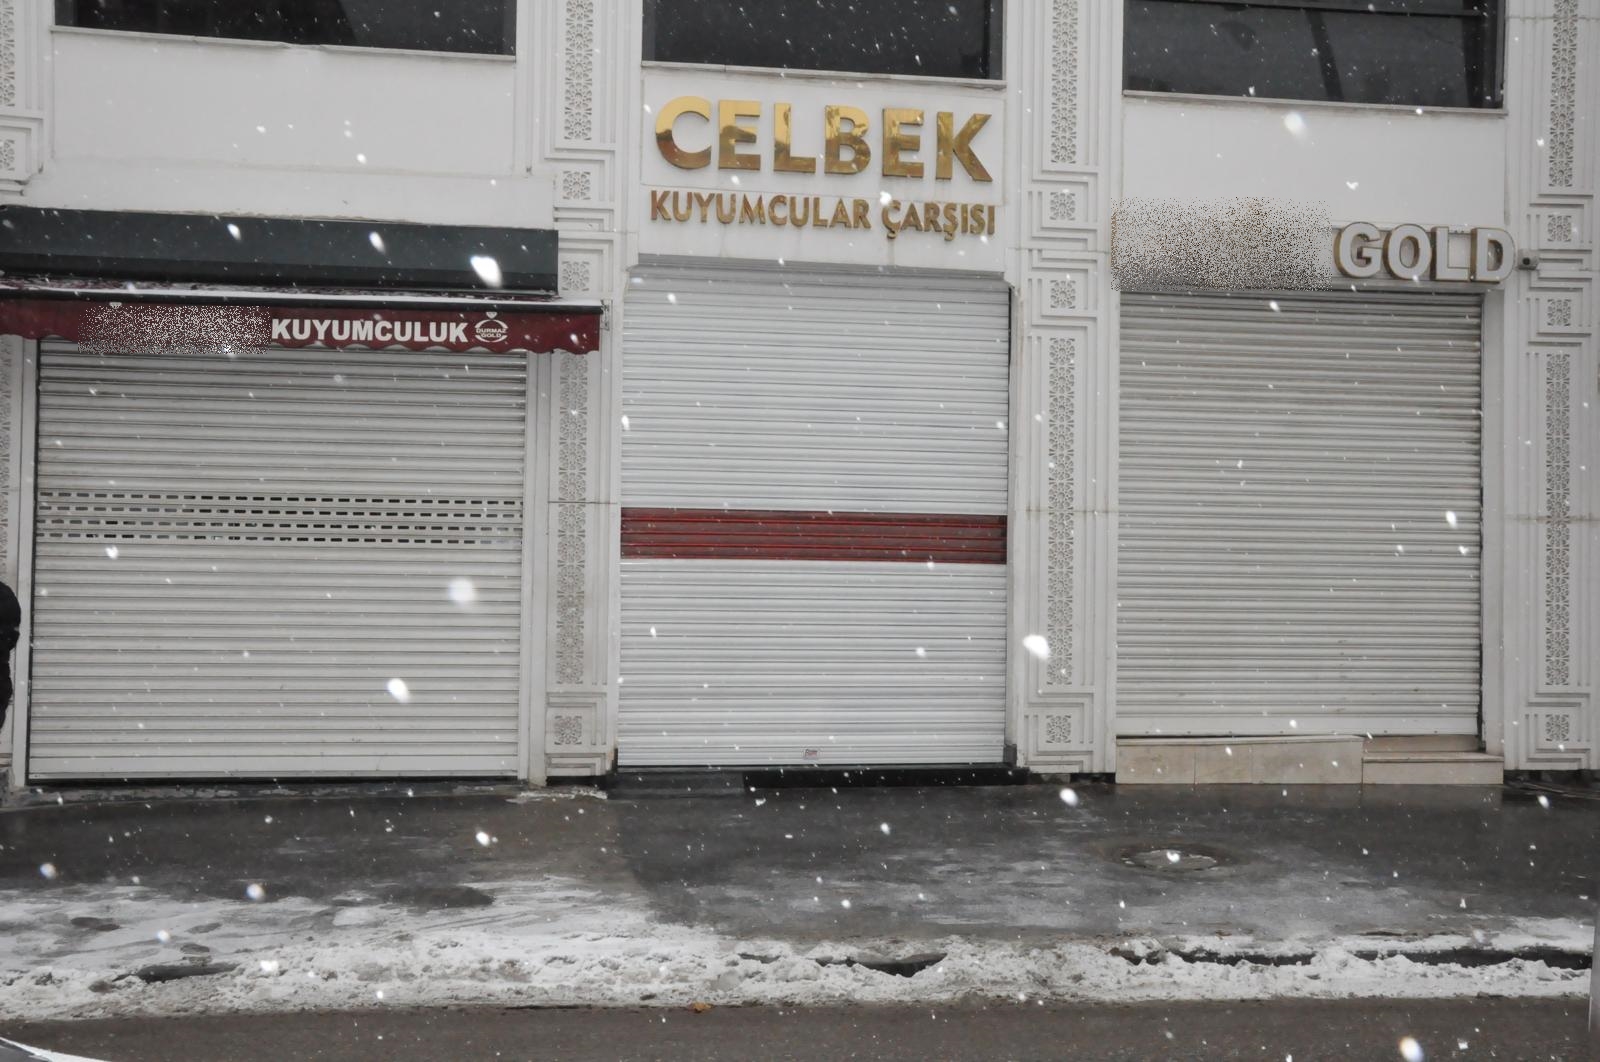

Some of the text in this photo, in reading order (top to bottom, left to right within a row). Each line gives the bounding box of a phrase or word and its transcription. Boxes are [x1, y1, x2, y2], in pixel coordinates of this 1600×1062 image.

[655, 96, 993, 182] CELBEK
[650, 190, 996, 241] KUYUMCULAR ÇARŞISI
[1334, 221, 1516, 284] GOLD
[271, 318, 469, 343] KUYUMCULUK
